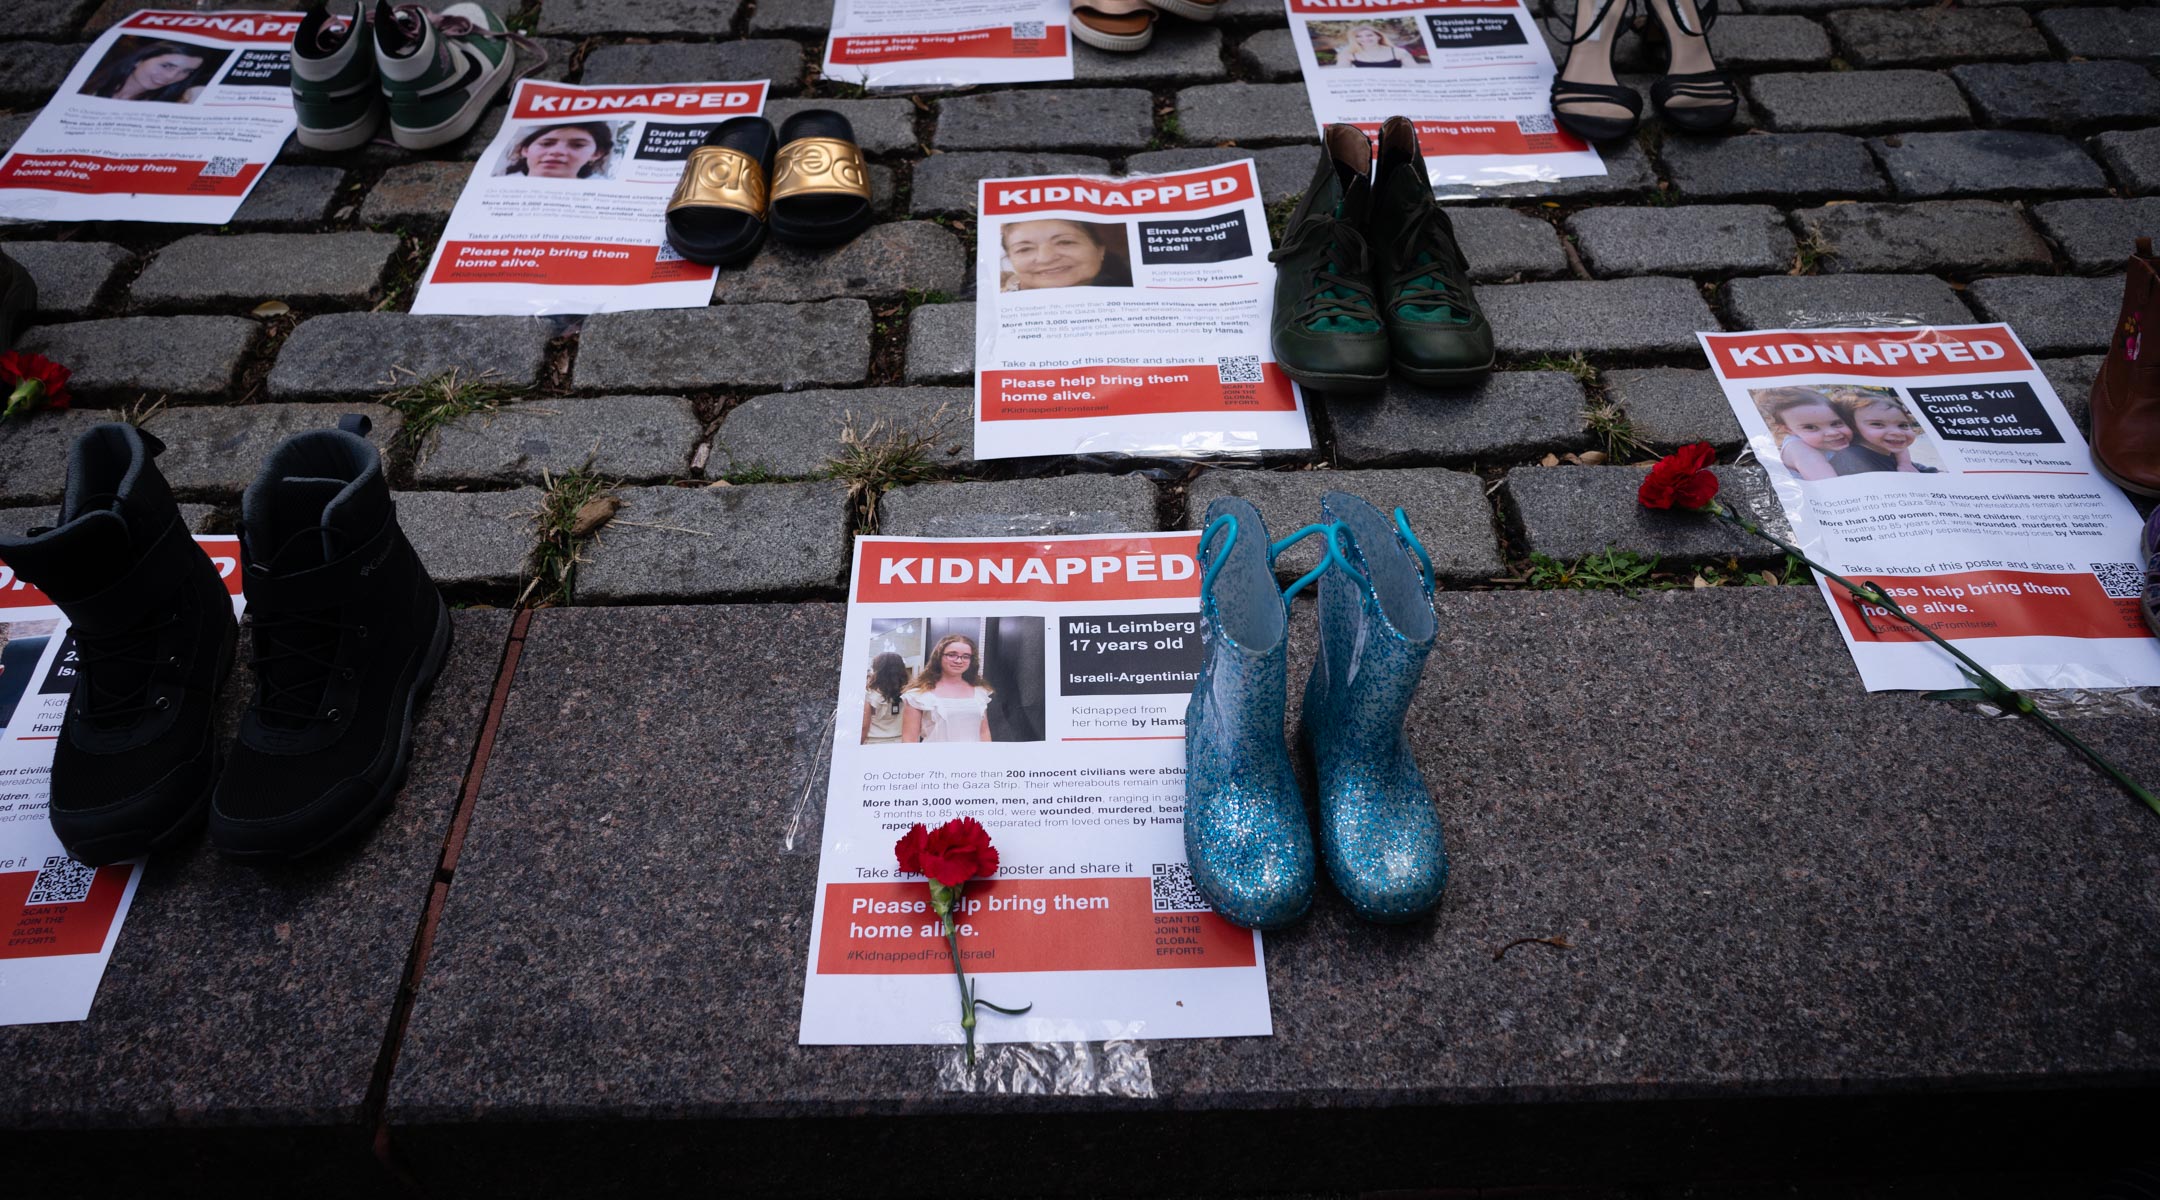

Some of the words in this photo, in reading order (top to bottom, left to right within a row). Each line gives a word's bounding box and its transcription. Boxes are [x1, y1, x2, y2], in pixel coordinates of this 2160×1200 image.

[140, 16, 300, 36] KIDNAPP
[891, 37, 919, 45] help
[922, 36, 956, 44] bring
[958, 32, 990, 41] them
[845, 47, 882, 55] home
[884, 45, 917, 53] alive.
[529, 92, 750, 112] KIDNAPPED
[649, 129, 686, 138] Dafna
[1423, 126, 1458, 135] bring
[1460, 125, 1495, 133] them
[648, 137, 662, 145] 15
[665, 138, 699, 147] years
[644, 144, 682, 154] Israeli
[22, 159, 67, 168] Please
[70, 159, 101, 172] help
[103, 164, 140, 174] bring
[142, 164, 177, 173] them
[13, 167, 52, 177] home
[54, 169, 90, 180] alive.
[999, 176, 1239, 207] KIDNAPPED
[1182, 219, 1239, 234] Avraham
[1166, 236, 1202, 244] years
[1205, 231, 1227, 241] old
[460, 247, 510, 257] Please
[513, 247, 545, 258] help
[549, 248, 588, 259] bring
[591, 249, 629, 259] them
[1148, 244, 1189, 252] Israeli
[455, 259, 497, 268] home
[501, 258, 540, 268] alive.
[1728, 339, 2006, 368] KIDNAPPED
[1001, 378, 1056, 389] Please
[1060, 376, 1096, 388] help
[1100, 375, 1144, 387] bring
[1148, 373, 1189, 384] them
[1001, 391, 1048, 403] home
[1053, 390, 1096, 401] alive.
[1920, 392, 1968, 403] Emma
[1972, 391, 1984, 400] &
[1985, 389, 2015, 399] Yuli
[1001, 404, 1109, 415] #KidnappedFromIsrael
[1927, 404, 1978, 414] Cunio,
[1935, 416, 1945, 424] 3
[1948, 415, 1990, 426] years
[1993, 414, 2018, 423] old
[1942, 426, 1989, 437] Israeli
[1992, 427, 2042, 437] babies
[1959, 447, 2014, 458] Kidnapped
[2016, 449, 2038, 457] from
[2020, 458, 2032, 466] by
[2035, 458, 2071, 466] Hamas
[879, 553, 1195, 584] KIDNAPPED
[1842, 564, 1872, 573] Take
[1886, 565, 1921, 574] photo
[1924, 564, 1936, 572] of
[1940, 561, 1963, 571] this
[1966, 558, 2002, 570] poster
[2031, 562, 2064, 571] share
[1921, 585, 1964, 599] help
[1967, 580, 2022, 596] bring
[2023, 582, 2070, 596] them
[1923, 602, 1974, 614] alive.
[1069, 622, 1101, 635] Mia
[1107, 620, 1196, 635] Leimberg
[1069, 639, 1090, 651] 17
[1097, 640, 1149, 654] years
[1154, 637, 1184, 650] old
[1071, 704, 1136, 718] Kidnapped
[1141, 704, 1168, 714] from
[1071, 718, 1092, 728] her
[1094, 718, 1128, 728] home
[1131, 718, 1147, 729] by
[864, 772, 879, 781] On
[883, 771, 925, 780] October
[929, 771, 947, 779] 7th,
[950, 771, 977, 779] more
[981, 770, 1003, 778] than
[1006, 770, 1026, 778] 200
[1029, 768, 1076, 778] innocent
[1080, 767, 1126, 776] civilians
[862, 783, 885, 792] from
[889, 782, 918, 791] Israel
[921, 781, 940, 790] into
[943, 781, 959, 790] the
[962, 781, 990, 789] Gaza
[993, 780, 1020, 790] Strip.
[1024, 780, 1049, 789] Their
[1053, 778, 1120, 788] whereabouts
[1123, 778, 1158, 787] remain
[862, 799, 891, 807] More
[894, 798, 919, 806] than
[922, 798, 951, 807] 3,000
[955, 798, 998, 806] women,
[1002, 797, 1029, 806] men,
[1032, 796, 1053, 805] and
[1057, 795, 1104, 803] children,
[1109, 794, 1147, 803] ranging
[1152, 794, 1161, 802] in
[874, 810, 880, 819] 3
[883, 809, 923, 818] months
[926, 809, 936, 817] to
[939, 809, 952, 817] 85
[955, 809, 984, 817] years
[988, 808, 1007, 817] old,
[1011, 808, 1037, 816] were
[1040, 806, 1094, 815] wounded,
[1098, 805, 1155, 813] murdered,
[855, 867, 889, 878] Take
[1000, 863, 1045, 877] poster
[1049, 863, 1076, 874] and
[1080, 862, 1120, 873] share
[1126, 862, 1133, 873] it
[852, 898, 926, 914] Please
[988, 895, 1046, 914] bring
[1054, 894, 1109, 910] them
[21, 906, 51, 916] SCAN
[17, 916, 42, 926] JOIN
[45, 916, 65, 924] THE
[1154, 915, 1183, 924] SCAN
[1186, 915, 1199, 924] TO
[12, 927, 55, 936] GLOBAL
[1155, 926, 1179, 935] JOIN
[1181, 925, 1201, 934] THE
[8, 936, 57, 946] EFFORTS
[1156, 936, 1198, 945] GLOBAL
[1156, 947, 1204, 956] EFFORTS
